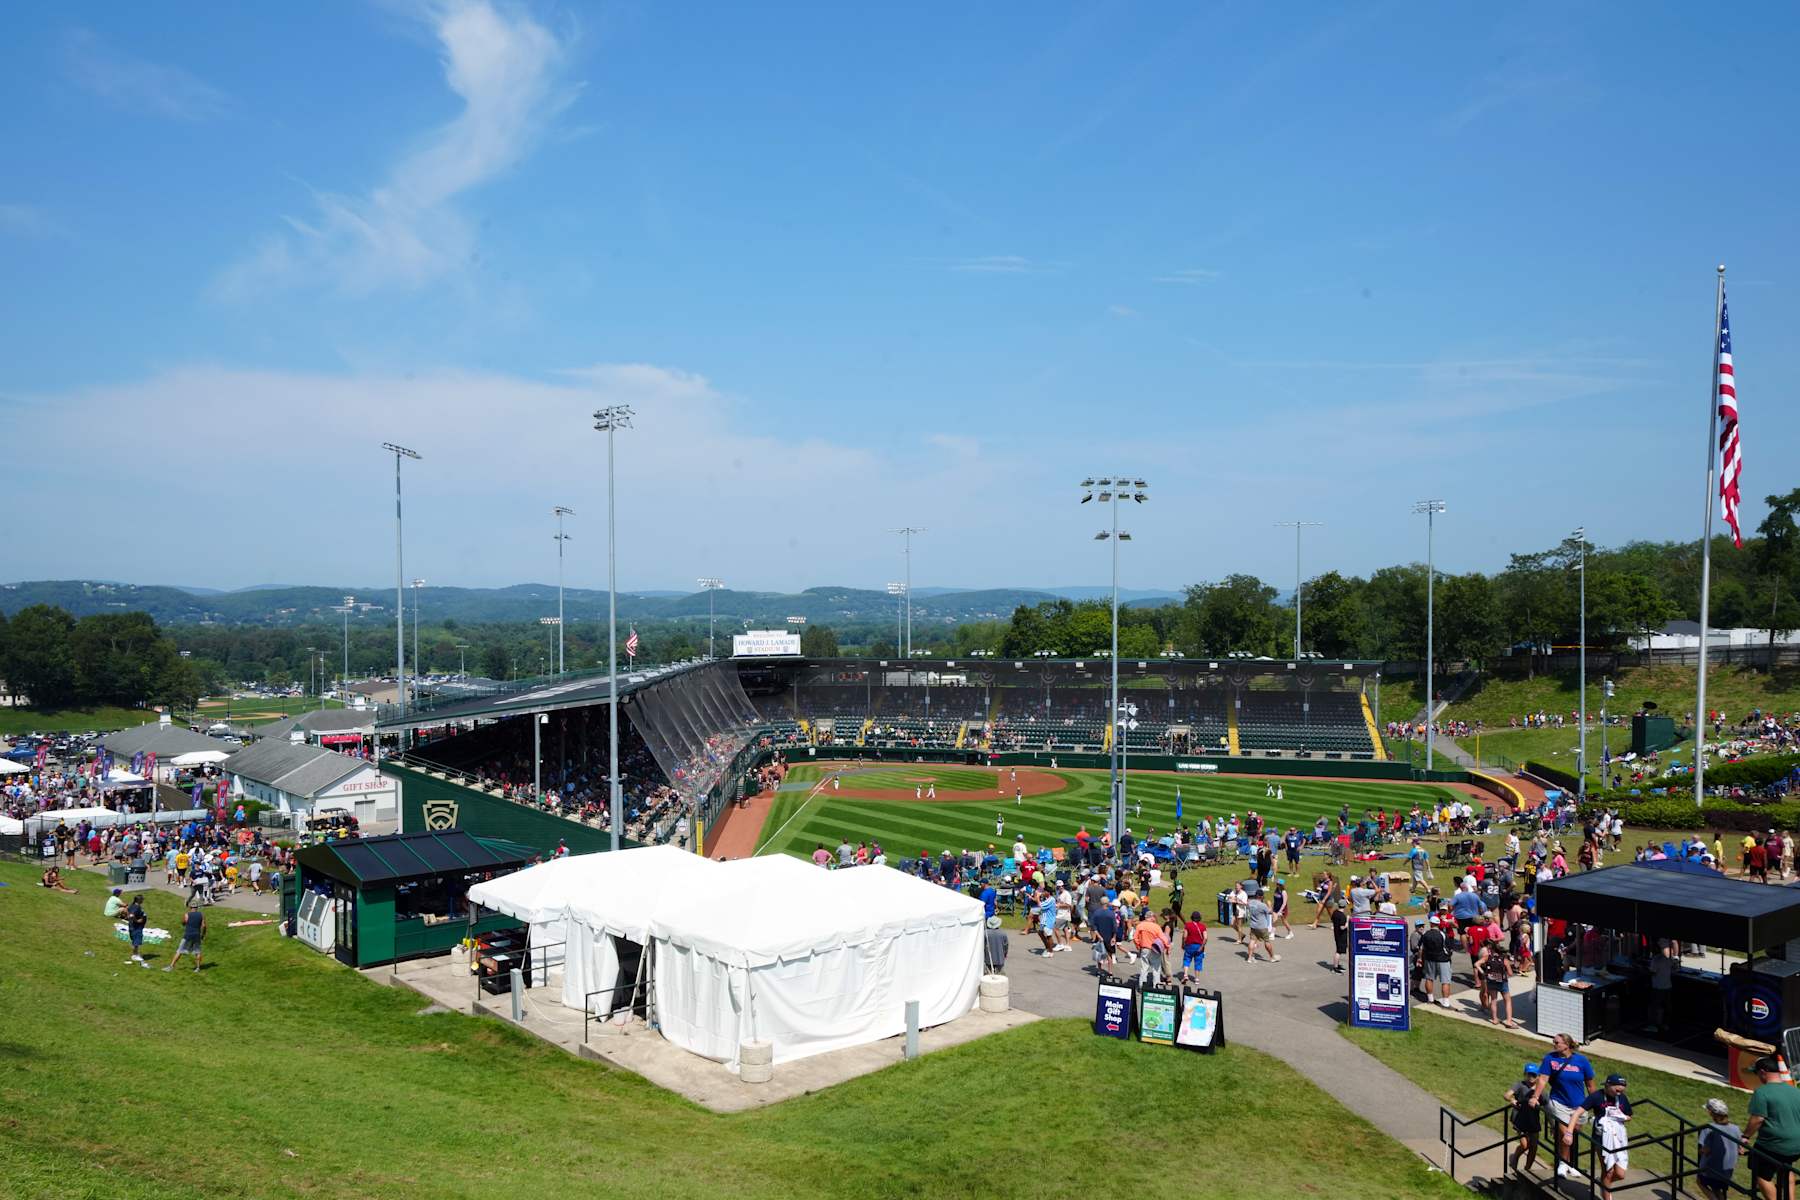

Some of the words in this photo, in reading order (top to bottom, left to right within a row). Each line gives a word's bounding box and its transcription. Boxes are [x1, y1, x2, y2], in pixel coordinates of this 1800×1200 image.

[343, 783, 363, 791] GIFT
[364, 781, 388, 790] SHOP
[1487, 885, 1500, 895] 22
[1105, 1000, 1123, 1010] Main
[1107, 1008, 1121, 1016] Gift
[1104, 1014, 1122, 1024] Shop
